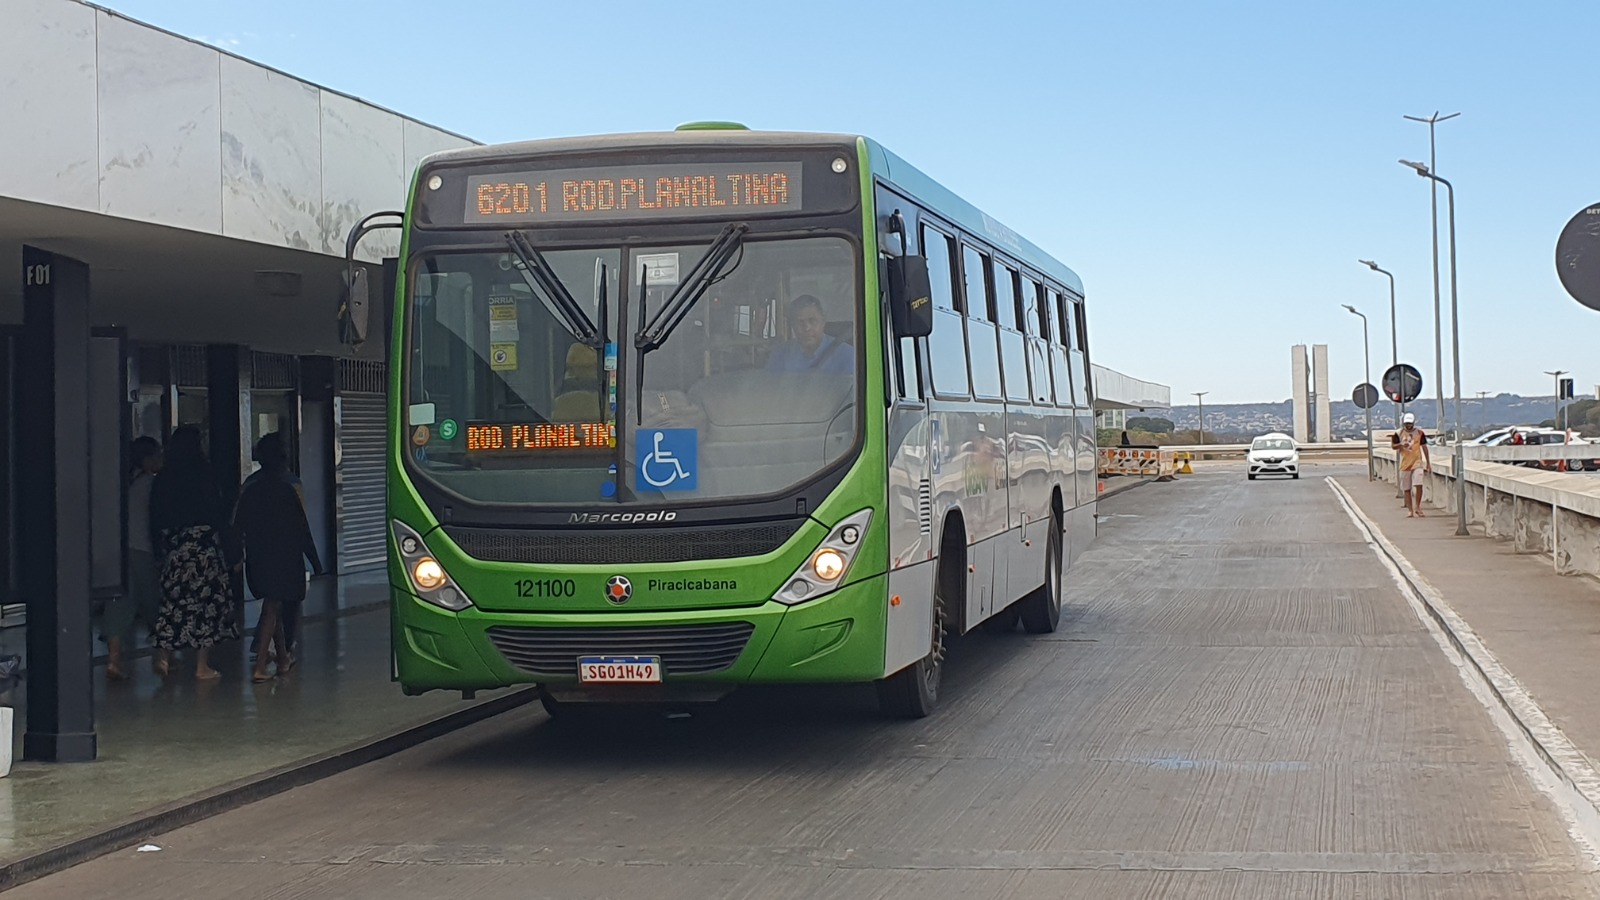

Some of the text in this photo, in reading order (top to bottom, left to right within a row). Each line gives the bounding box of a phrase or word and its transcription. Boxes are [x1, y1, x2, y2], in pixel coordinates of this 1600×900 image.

[27, 263, 50, 286] F01
[489, 296, 515, 305] ORRIA
[468, 422, 614, 449] ROD. PLANALTIN
[567, 510, 678, 524] Marcopolo
[514, 579, 576, 598] 121100
[648, 578, 738, 592] Piracicabana
